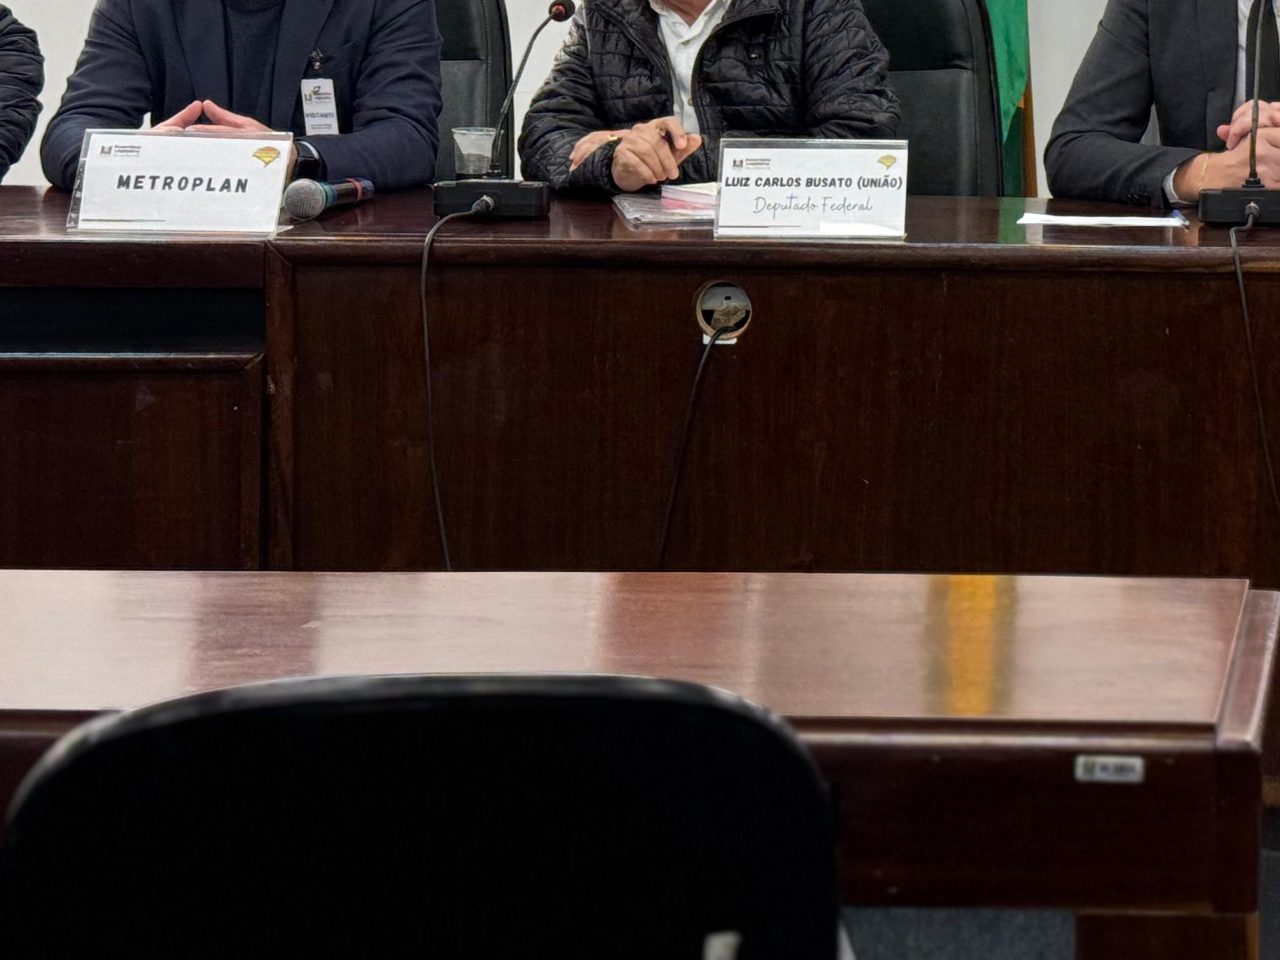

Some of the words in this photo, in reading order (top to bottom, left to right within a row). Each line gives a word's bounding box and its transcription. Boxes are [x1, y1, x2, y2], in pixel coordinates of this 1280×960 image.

[116, 174, 249, 193] METROPLAN
[725, 177, 750, 187] LUIZ
[755, 177, 802, 188] CARLOS
[805, 177, 853, 188] BUSATO
[857, 174, 903, 190] (UNIÃO)
[752, 193, 817, 219] Deputado
[822, 196, 875, 214] Federal
